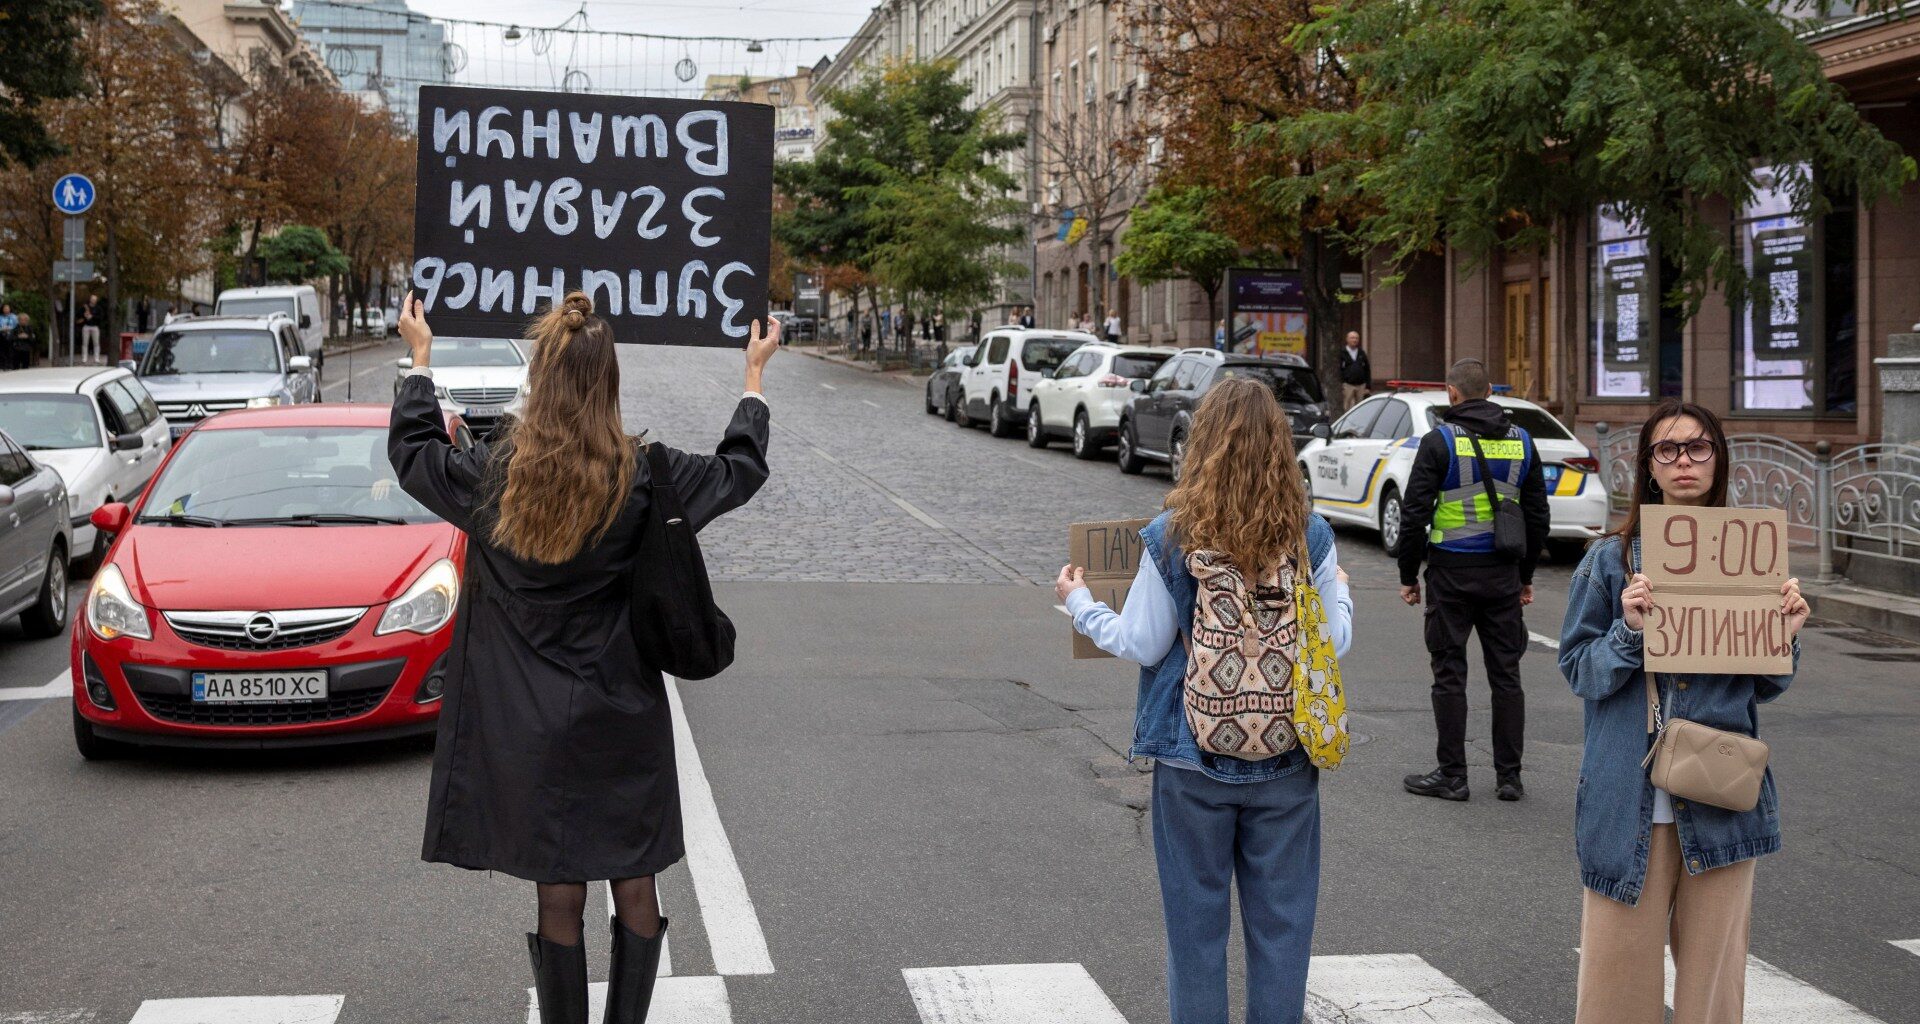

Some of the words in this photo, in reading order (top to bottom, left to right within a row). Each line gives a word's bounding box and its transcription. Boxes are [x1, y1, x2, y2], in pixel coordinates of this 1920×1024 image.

[1497, 443, 1522, 456] POLICE
[1646, 604, 1792, 658] ЗУПИНИСЬ
[206, 678, 236, 698] AA
[240, 678, 286, 697] 8510
[290, 676, 320, 695] XC
